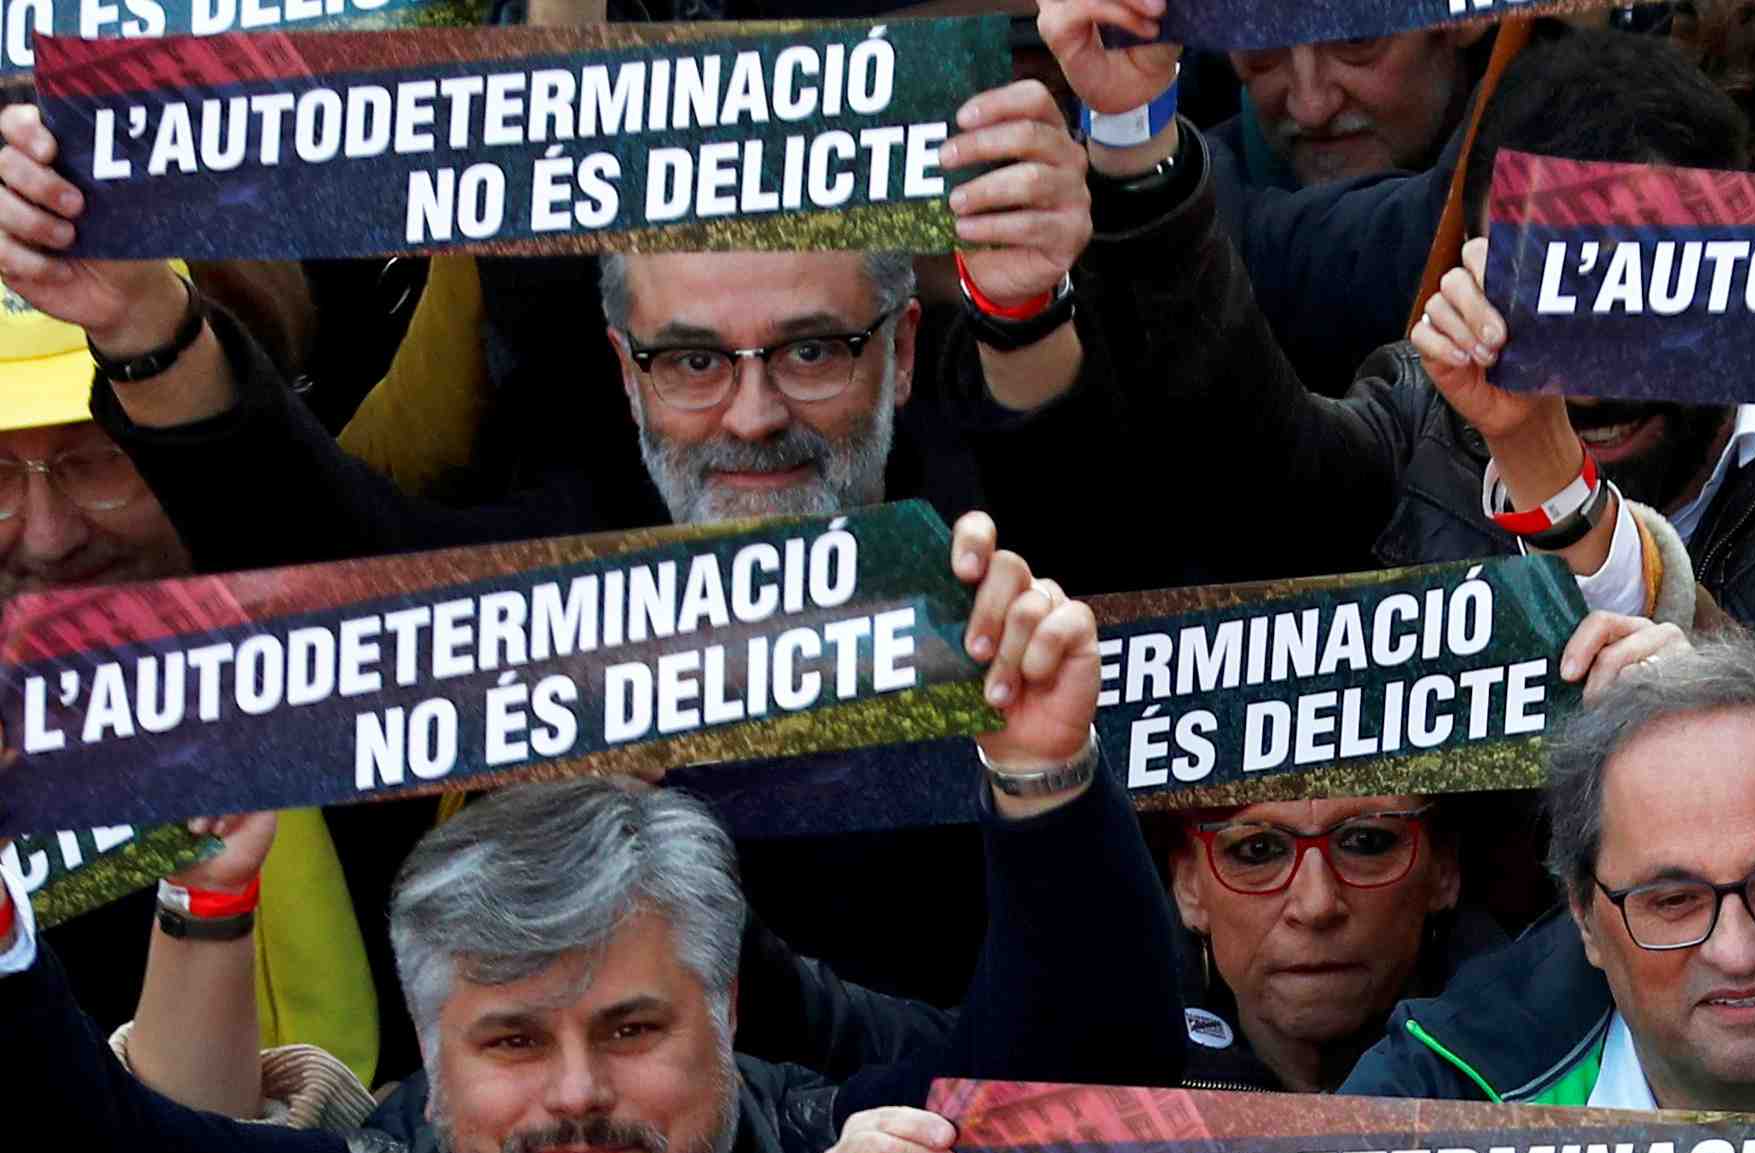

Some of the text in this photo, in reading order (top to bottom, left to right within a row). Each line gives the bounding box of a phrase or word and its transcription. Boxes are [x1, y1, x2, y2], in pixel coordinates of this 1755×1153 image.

[92, 24, 895, 180] L'AUTODETERMINACIÓ
[405, 121, 949, 243] NO ÉS DELICTE
[24, 516, 857, 754] L'AUTODETERMINACIÓ
[355, 607, 916, 791] NO ÉS DELICTE
[1127, 658, 1548, 789] ÉS DELICTE
